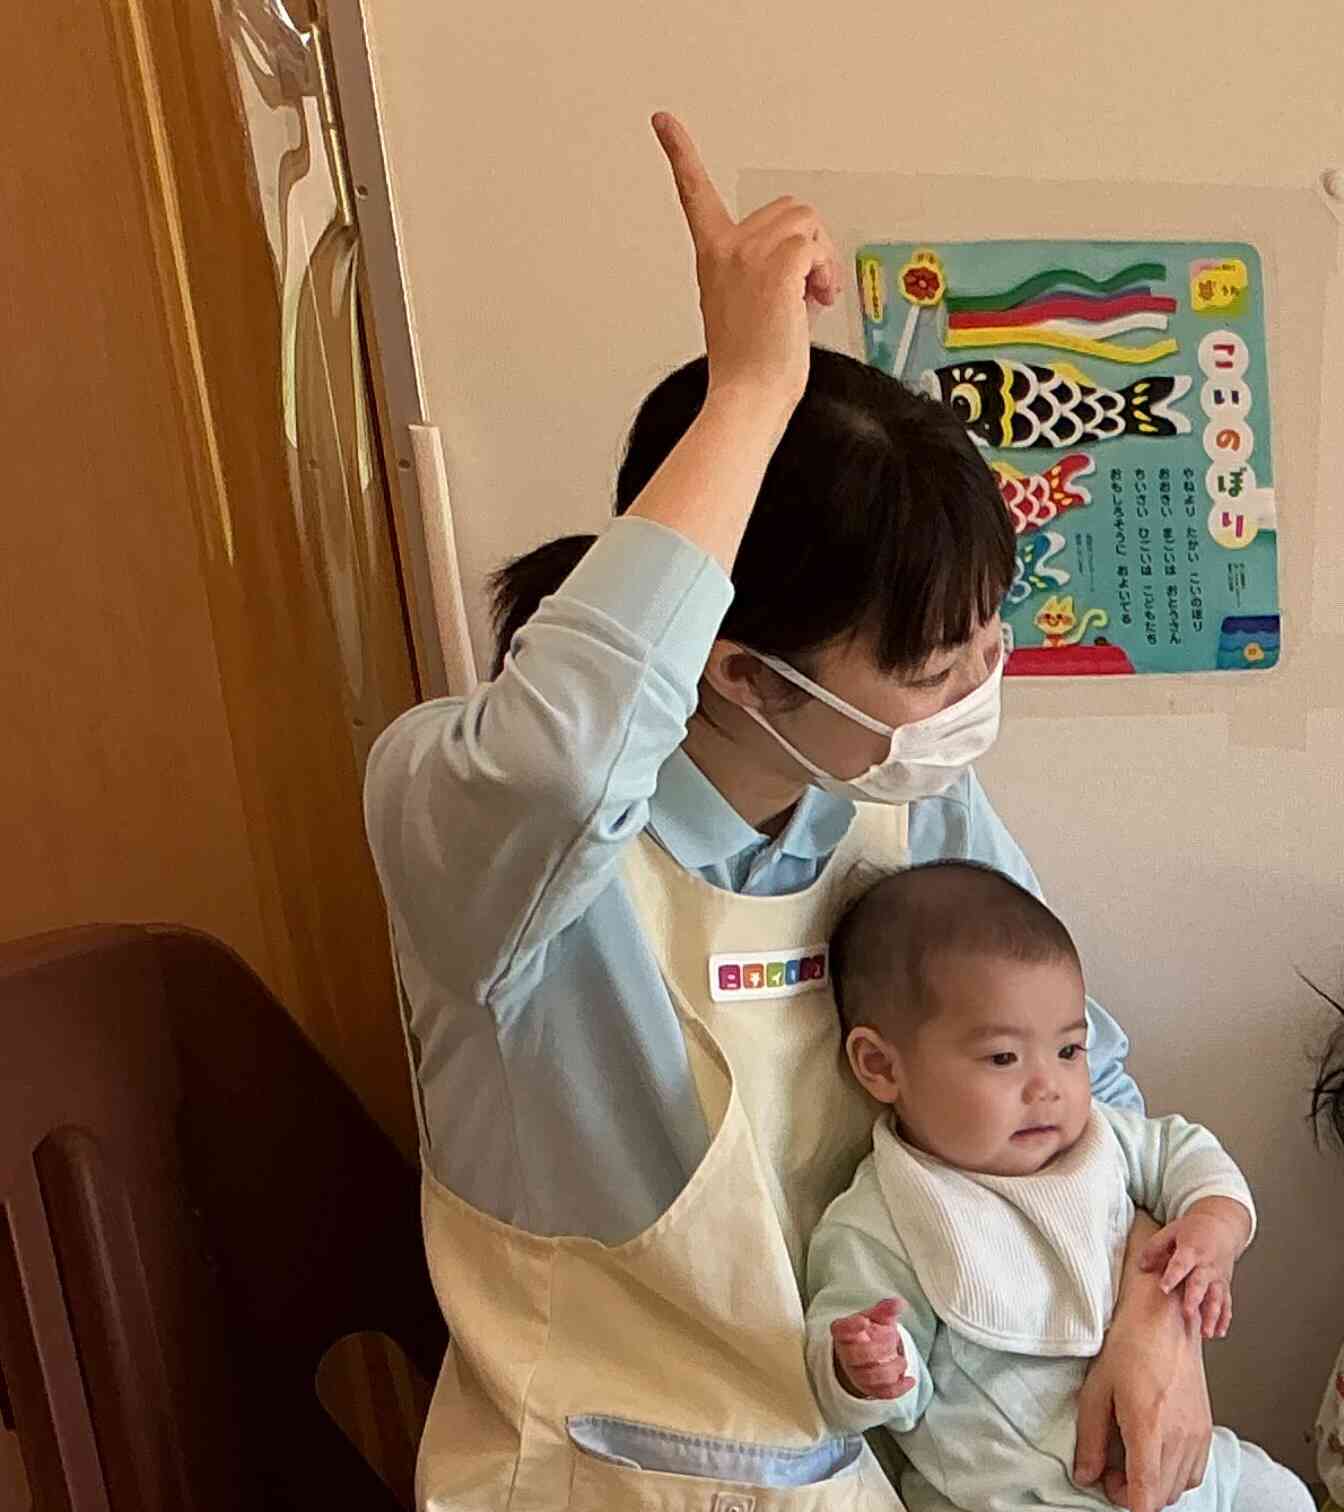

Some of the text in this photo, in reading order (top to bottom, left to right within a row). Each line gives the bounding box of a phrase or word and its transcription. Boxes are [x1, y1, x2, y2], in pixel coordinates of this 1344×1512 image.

[1213, 343, 1247, 538] こいのぼり
[1135, 468, 1148, 518] ちいさい
[1159, 468, 1173, 518] おおきい
[1183, 467, 1196, 517] やねより
